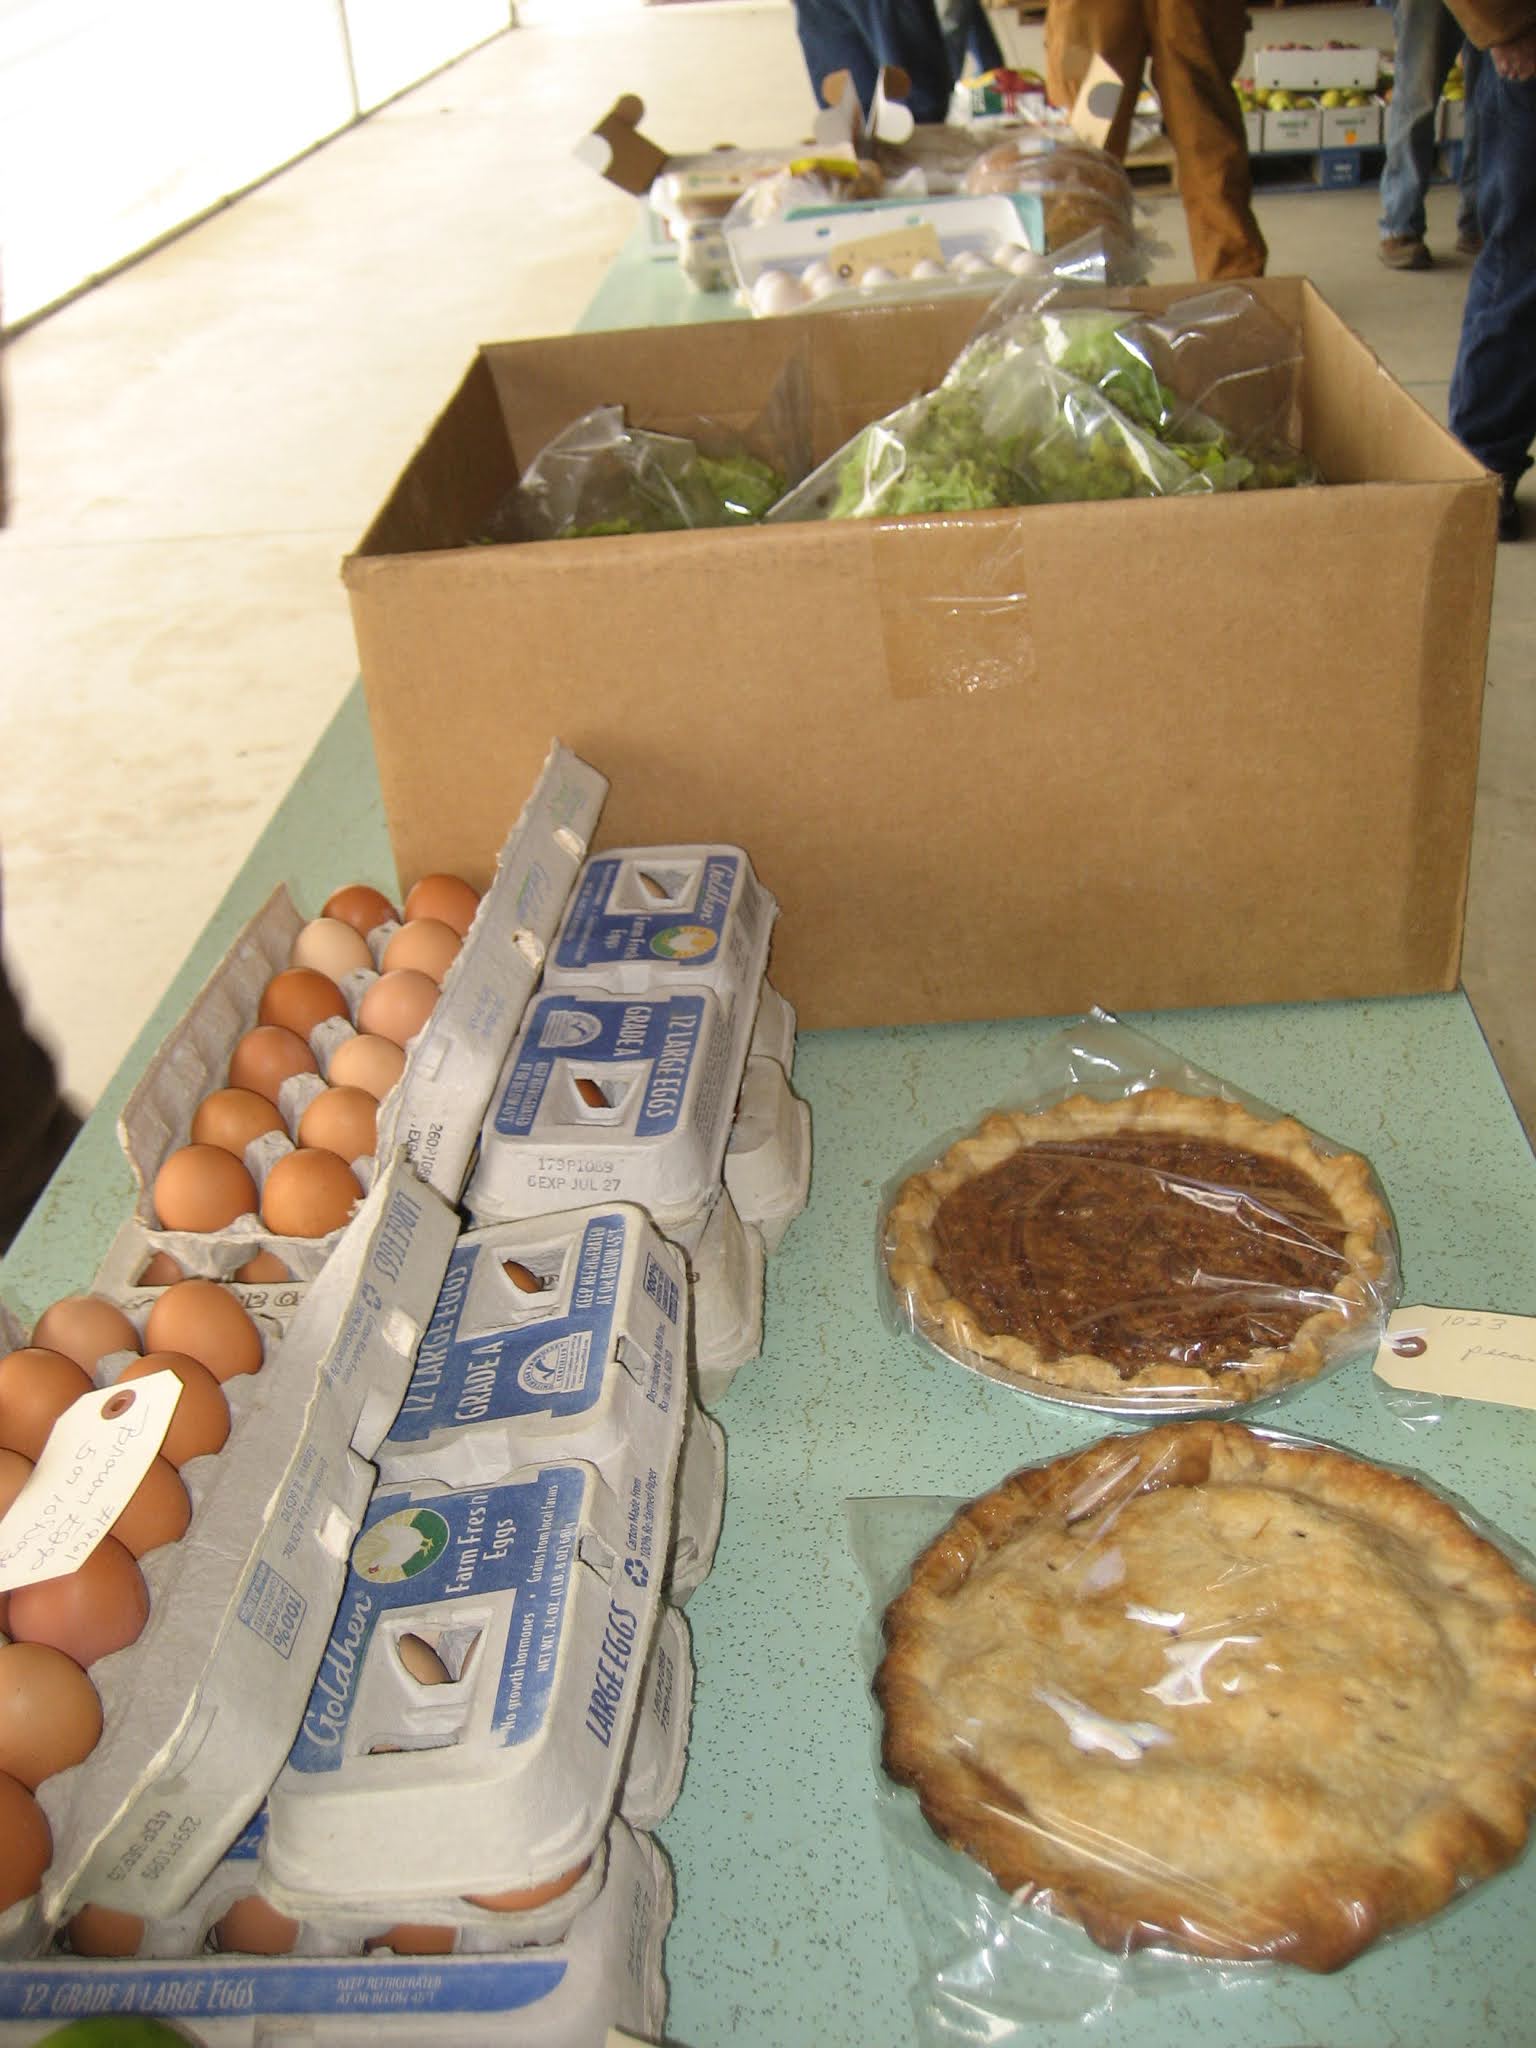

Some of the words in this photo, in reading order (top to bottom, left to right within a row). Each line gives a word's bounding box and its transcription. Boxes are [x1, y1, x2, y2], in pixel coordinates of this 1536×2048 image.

[615, 1005, 653, 1049] GRADE
[668, 1014, 697, 1029] 12
[613, 1048, 641, 1057] A
[656, 1030, 694, 1076] LARGE
[646, 1078, 682, 1119] EGGS
[571, 1177, 598, 1191] JUL
[602, 1178, 622, 1192] 27
[575, 1286, 595, 1308] KEEP
[596, 1294, 614, 1306] AT
[411, 1319, 454, 1389] LARGE
[471, 1339, 504, 1356] A
[400, 1392, 436, 1414] 12
[455, 1355, 501, 1421] GRADE
[645, 1467, 658, 1493] Paper
[541, 1484, 559, 1510] farms
[628, 1499, 641, 1522] Made
[457, 1492, 490, 1546] Fresh
[536, 1510, 555, 1533] local
[483, 1517, 518, 1562] Eggs
[532, 1532, 551, 1554] from
[625, 1522, 639, 1552] Carton
[640, 1535, 652, 1560] 100%
[446, 1548, 480, 1594] Farm
[526, 1552, 546, 1583] Grains
[273, 1593, 303, 1648] 100%
[602, 1597, 638, 1673] EGGS
[510, 1611, 536, 1668] hormones
[303, 1593, 373, 1748] Goldhen
[536, 1652, 553, 1673] NET
[508, 1667, 526, 1712] growth
[585, 1656, 625, 1749] LARGE
[500, 1712, 518, 1731] No
[19, 1983, 50, 2013] 12
[51, 1982, 119, 2012] GRADE
[118, 1981, 139, 2010] A
[138, 1980, 204, 2011] LARGE
[206, 1977, 258, 2009] EGGS
